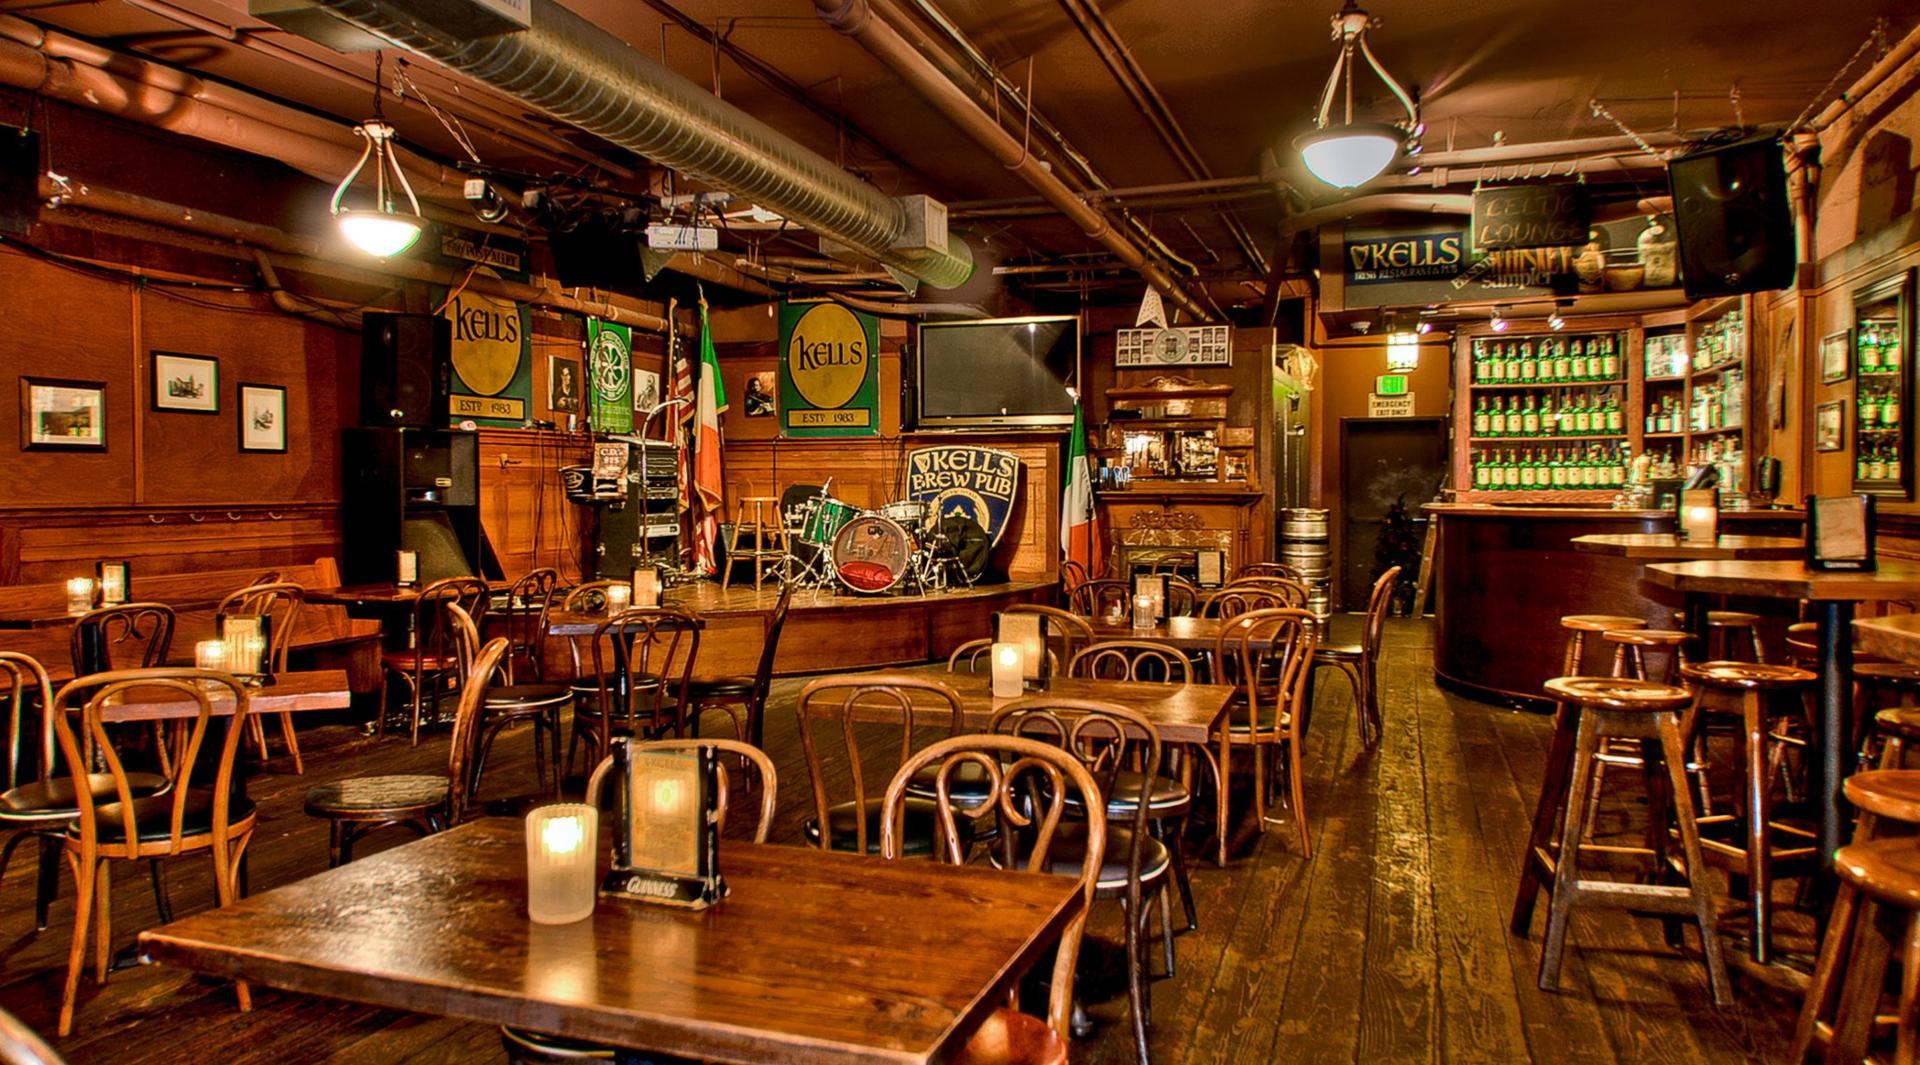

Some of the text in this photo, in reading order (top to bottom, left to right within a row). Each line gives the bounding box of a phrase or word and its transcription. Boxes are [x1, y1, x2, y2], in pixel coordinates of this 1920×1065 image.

[1479, 222, 1585, 245] LOUNGE
[1371, 237, 1460, 270] KELLS
[833, 412, 855, 424] 1983
[931, 450, 1014, 478] KELLS
[912, 471, 971, 491] BREW
[975, 472, 1012, 496] PUB
